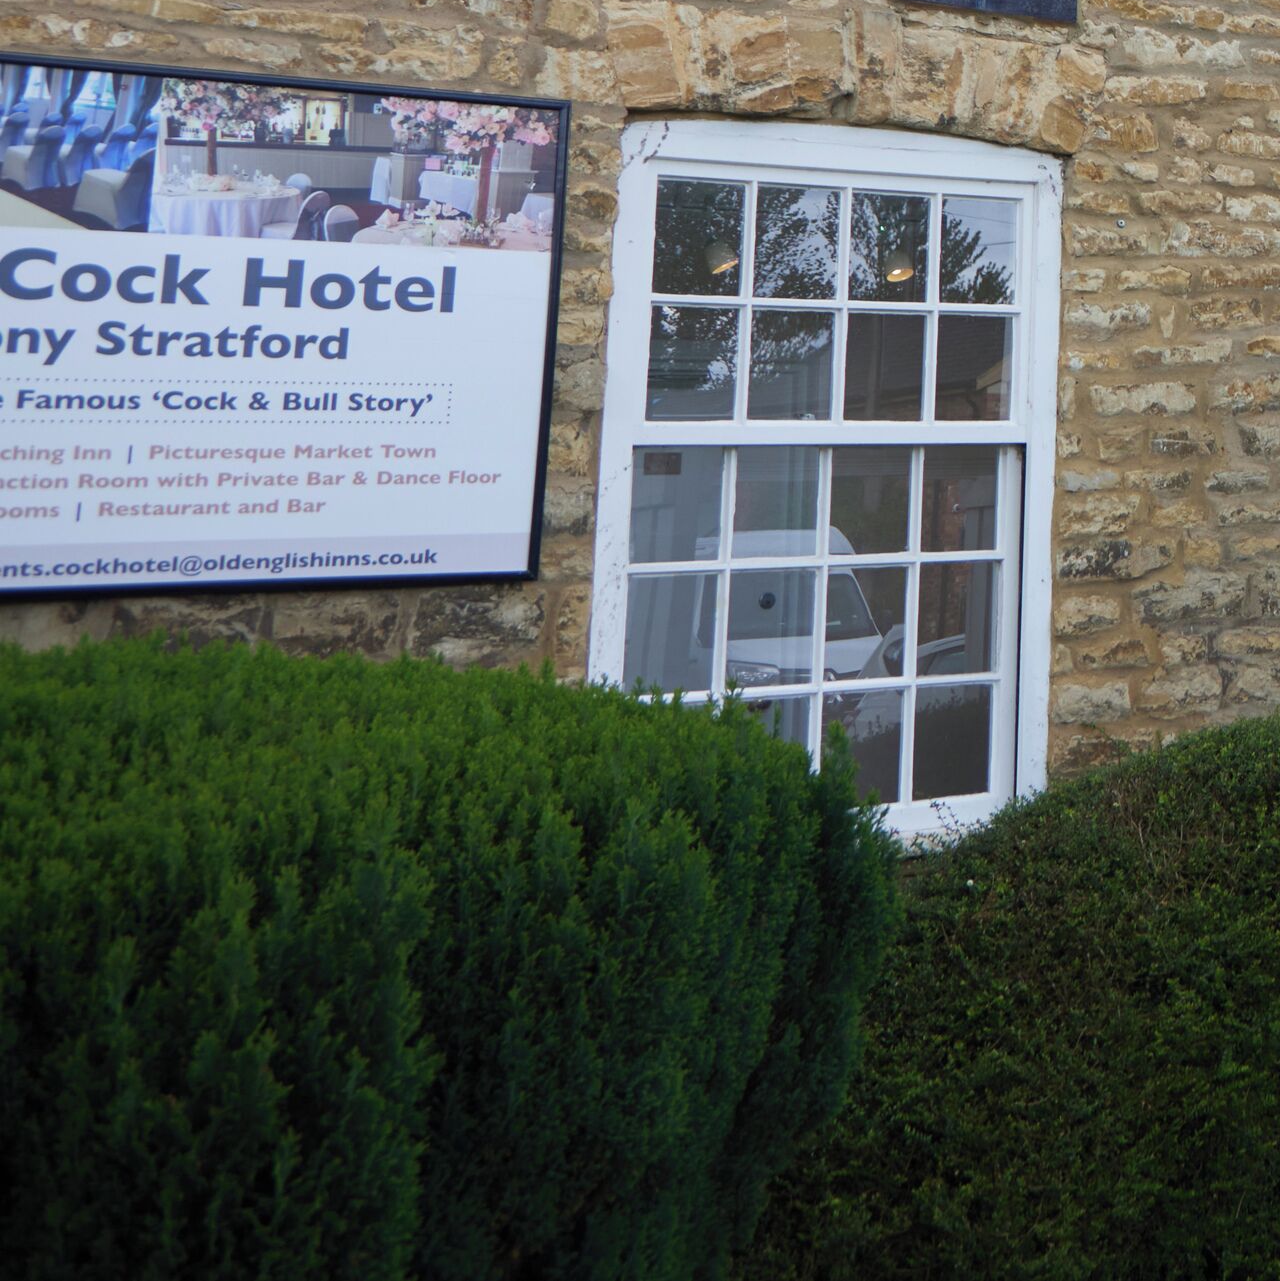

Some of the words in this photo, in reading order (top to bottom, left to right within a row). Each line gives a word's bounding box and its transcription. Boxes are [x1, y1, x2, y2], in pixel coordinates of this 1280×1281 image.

[0, 247, 211, 305] Cock
[242, 257, 457, 313] Hotel
[0, 327, 76, 365] ny
[96, 321, 349, 360] Stratford
[16, 389, 141, 410] Famous
[248, 392, 270, 411] &
[282, 392, 338, 411] Bull
[73, 445, 112, 460] Inn
[148, 445, 286, 464] Picturesque
[294, 444, 373, 459] Market
[380, 444, 437, 459] Town
[78, 473, 149, 489] Room
[157, 472, 209, 488] with
[217, 472, 299, 488] Private
[306, 472, 346, 486] Bar
[352, 471, 368, 486] &
[377, 471, 441, 485] Dance
[448, 470, 502, 485] Floor
[98, 501, 232, 518] Restaurant
[238, 500, 279, 514] and
[287, 499, 327, 513] Bar
[0, 548, 438, 578] nts.cockhotel@oldenglishinns.co.uk
